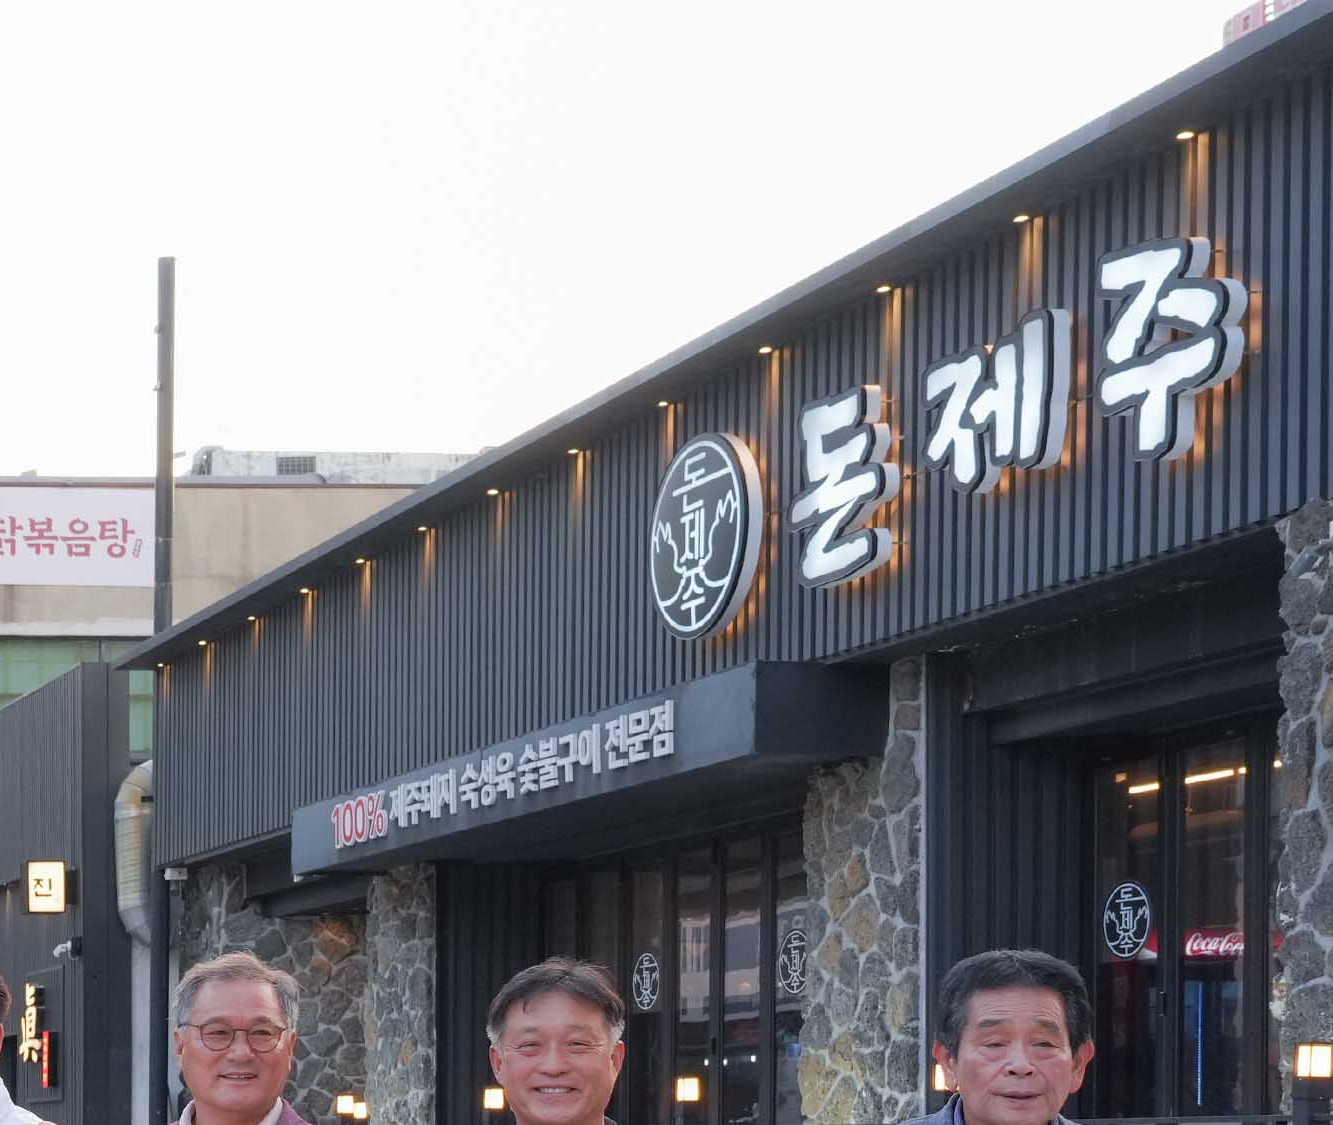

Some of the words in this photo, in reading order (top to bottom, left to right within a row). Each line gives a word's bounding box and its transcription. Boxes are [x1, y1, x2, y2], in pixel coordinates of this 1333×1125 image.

[789, 236, 1247, 588] 돈제주
[331, 790, 388, 849] 100%
[517, 723, 602, 796] 숯불구이
[604, 698, 675, 770] 전문점
[33, 878, 52, 898] 진
